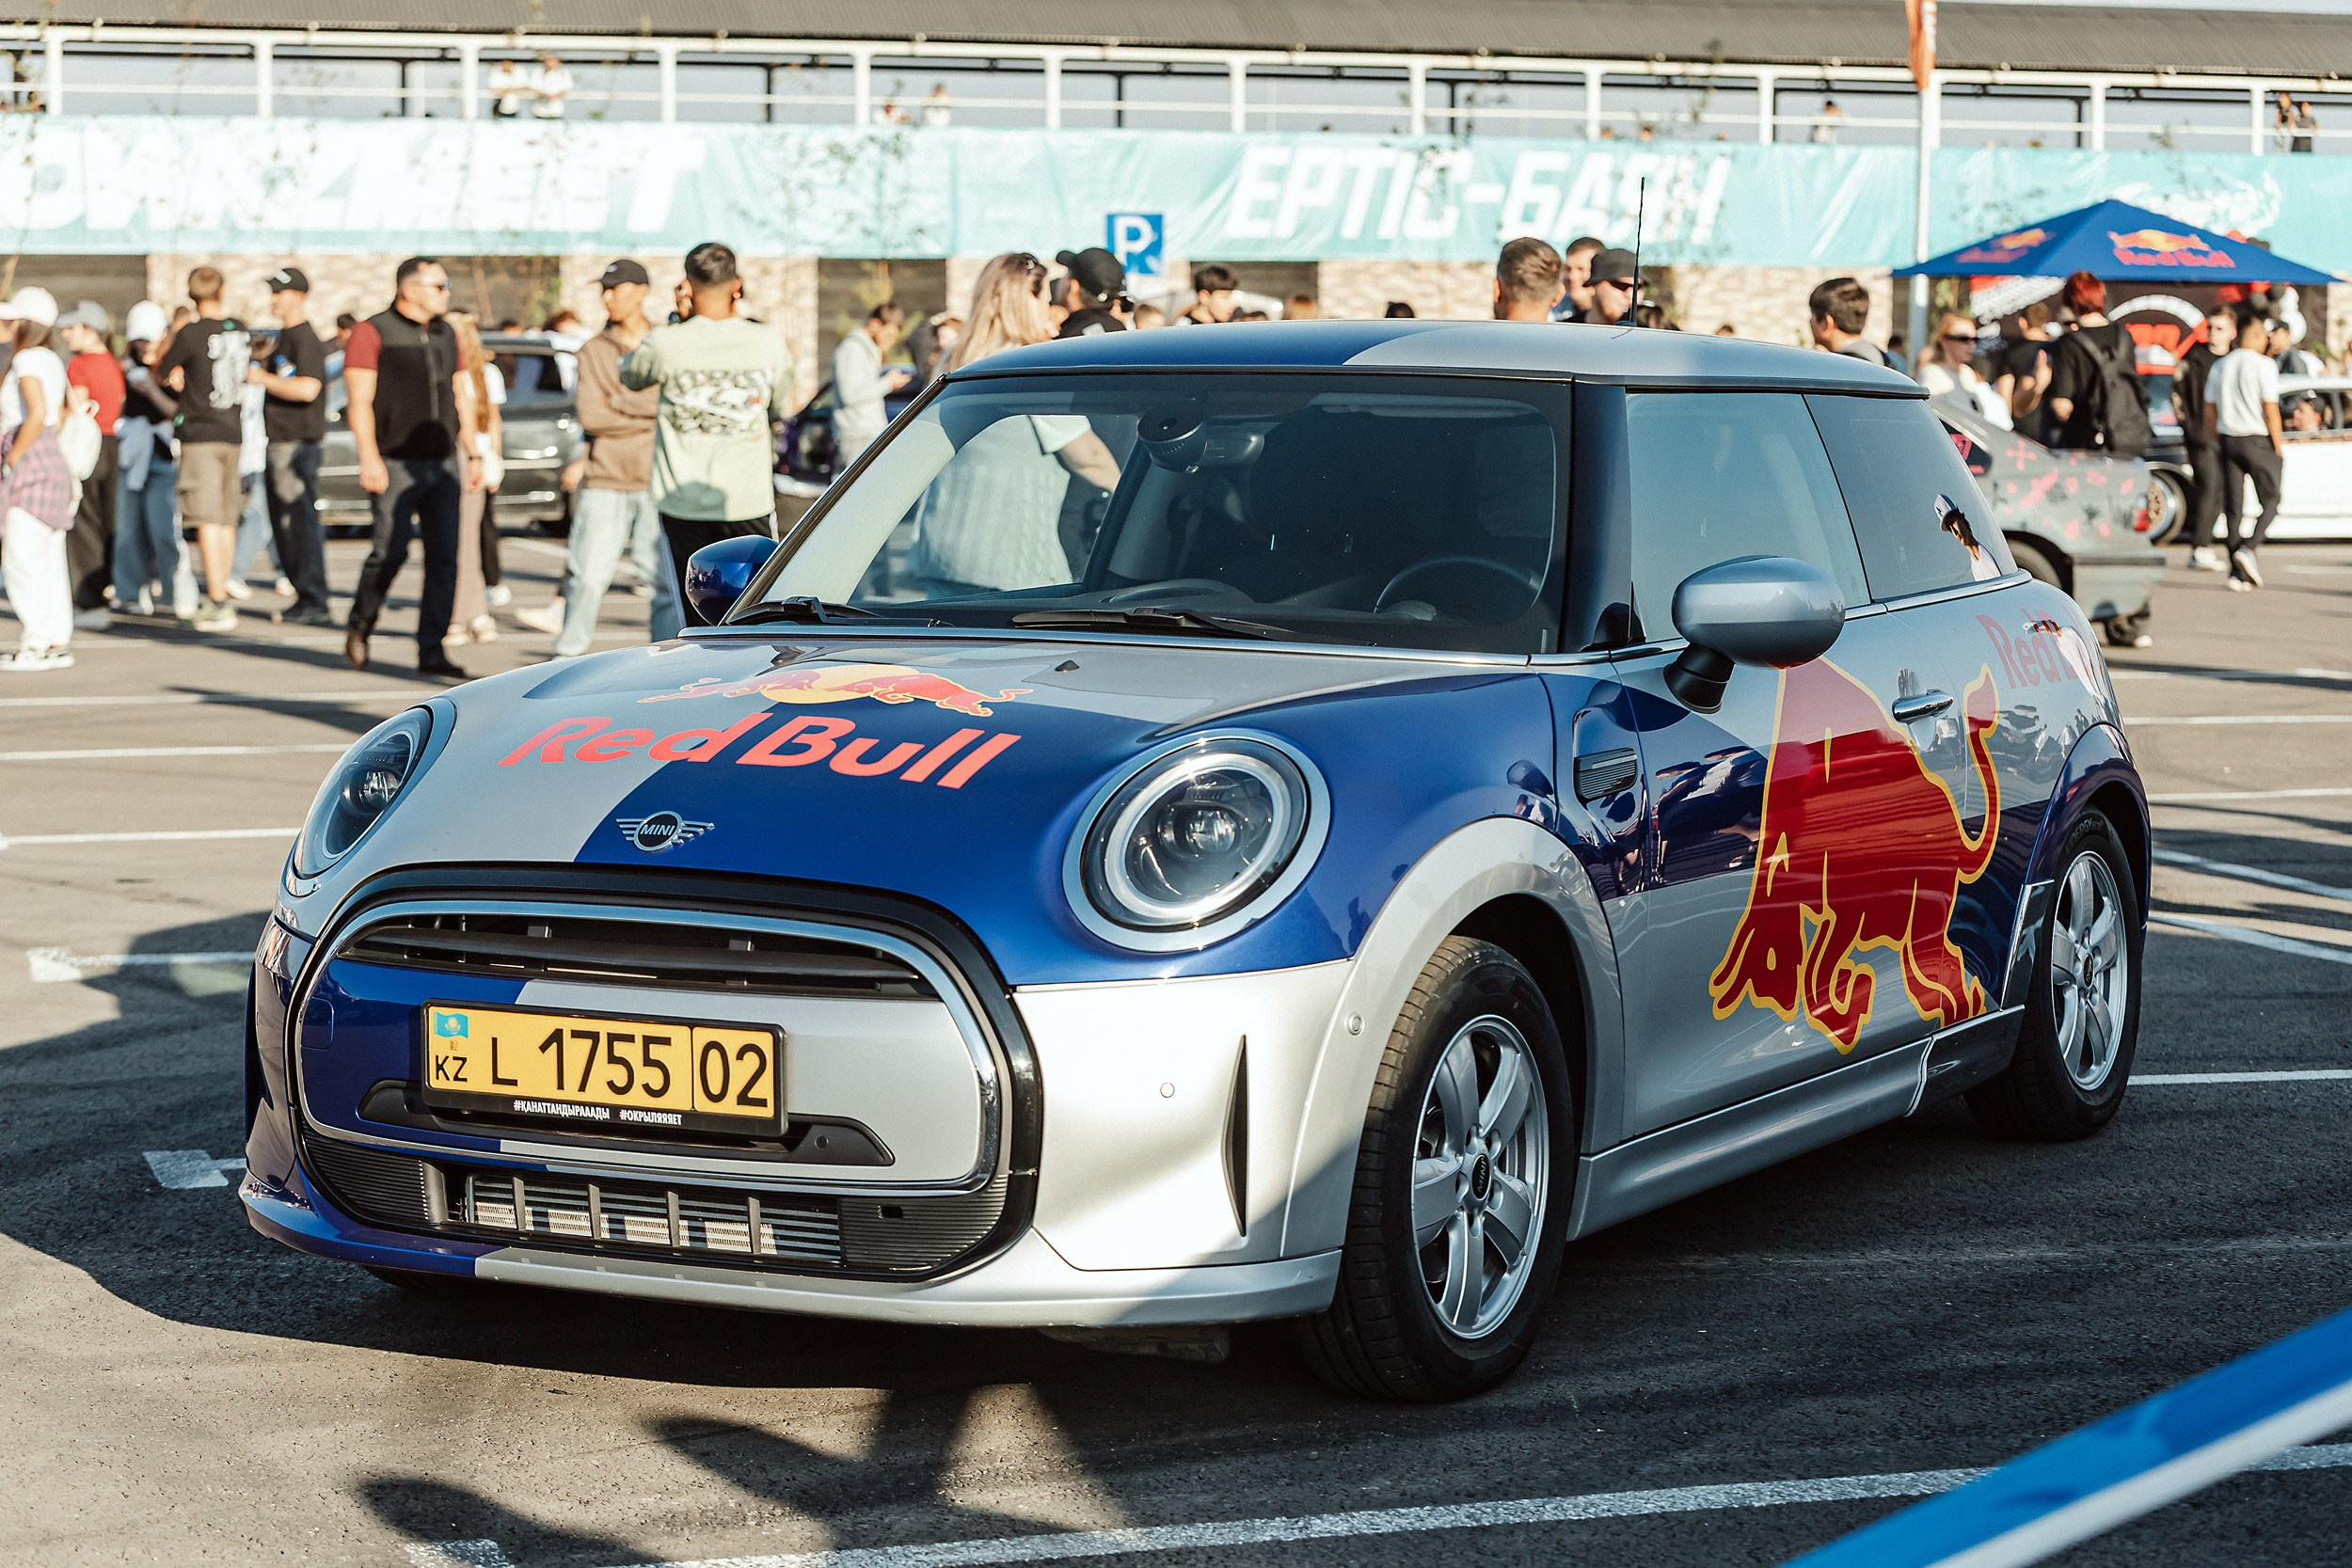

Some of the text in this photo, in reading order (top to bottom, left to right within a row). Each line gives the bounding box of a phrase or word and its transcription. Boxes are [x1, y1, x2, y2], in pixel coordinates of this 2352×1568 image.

[1114, 215, 1153, 266] P
[497, 712, 1022, 789] Red Bull
[640, 824, 675, 836] MINI
[436, 1054, 468, 1082] KZ
[492, 1028, 768, 1108] L 1755 02
[619, 1110, 682, 1126] #ОКРЫЛЯЯЯЕТ
